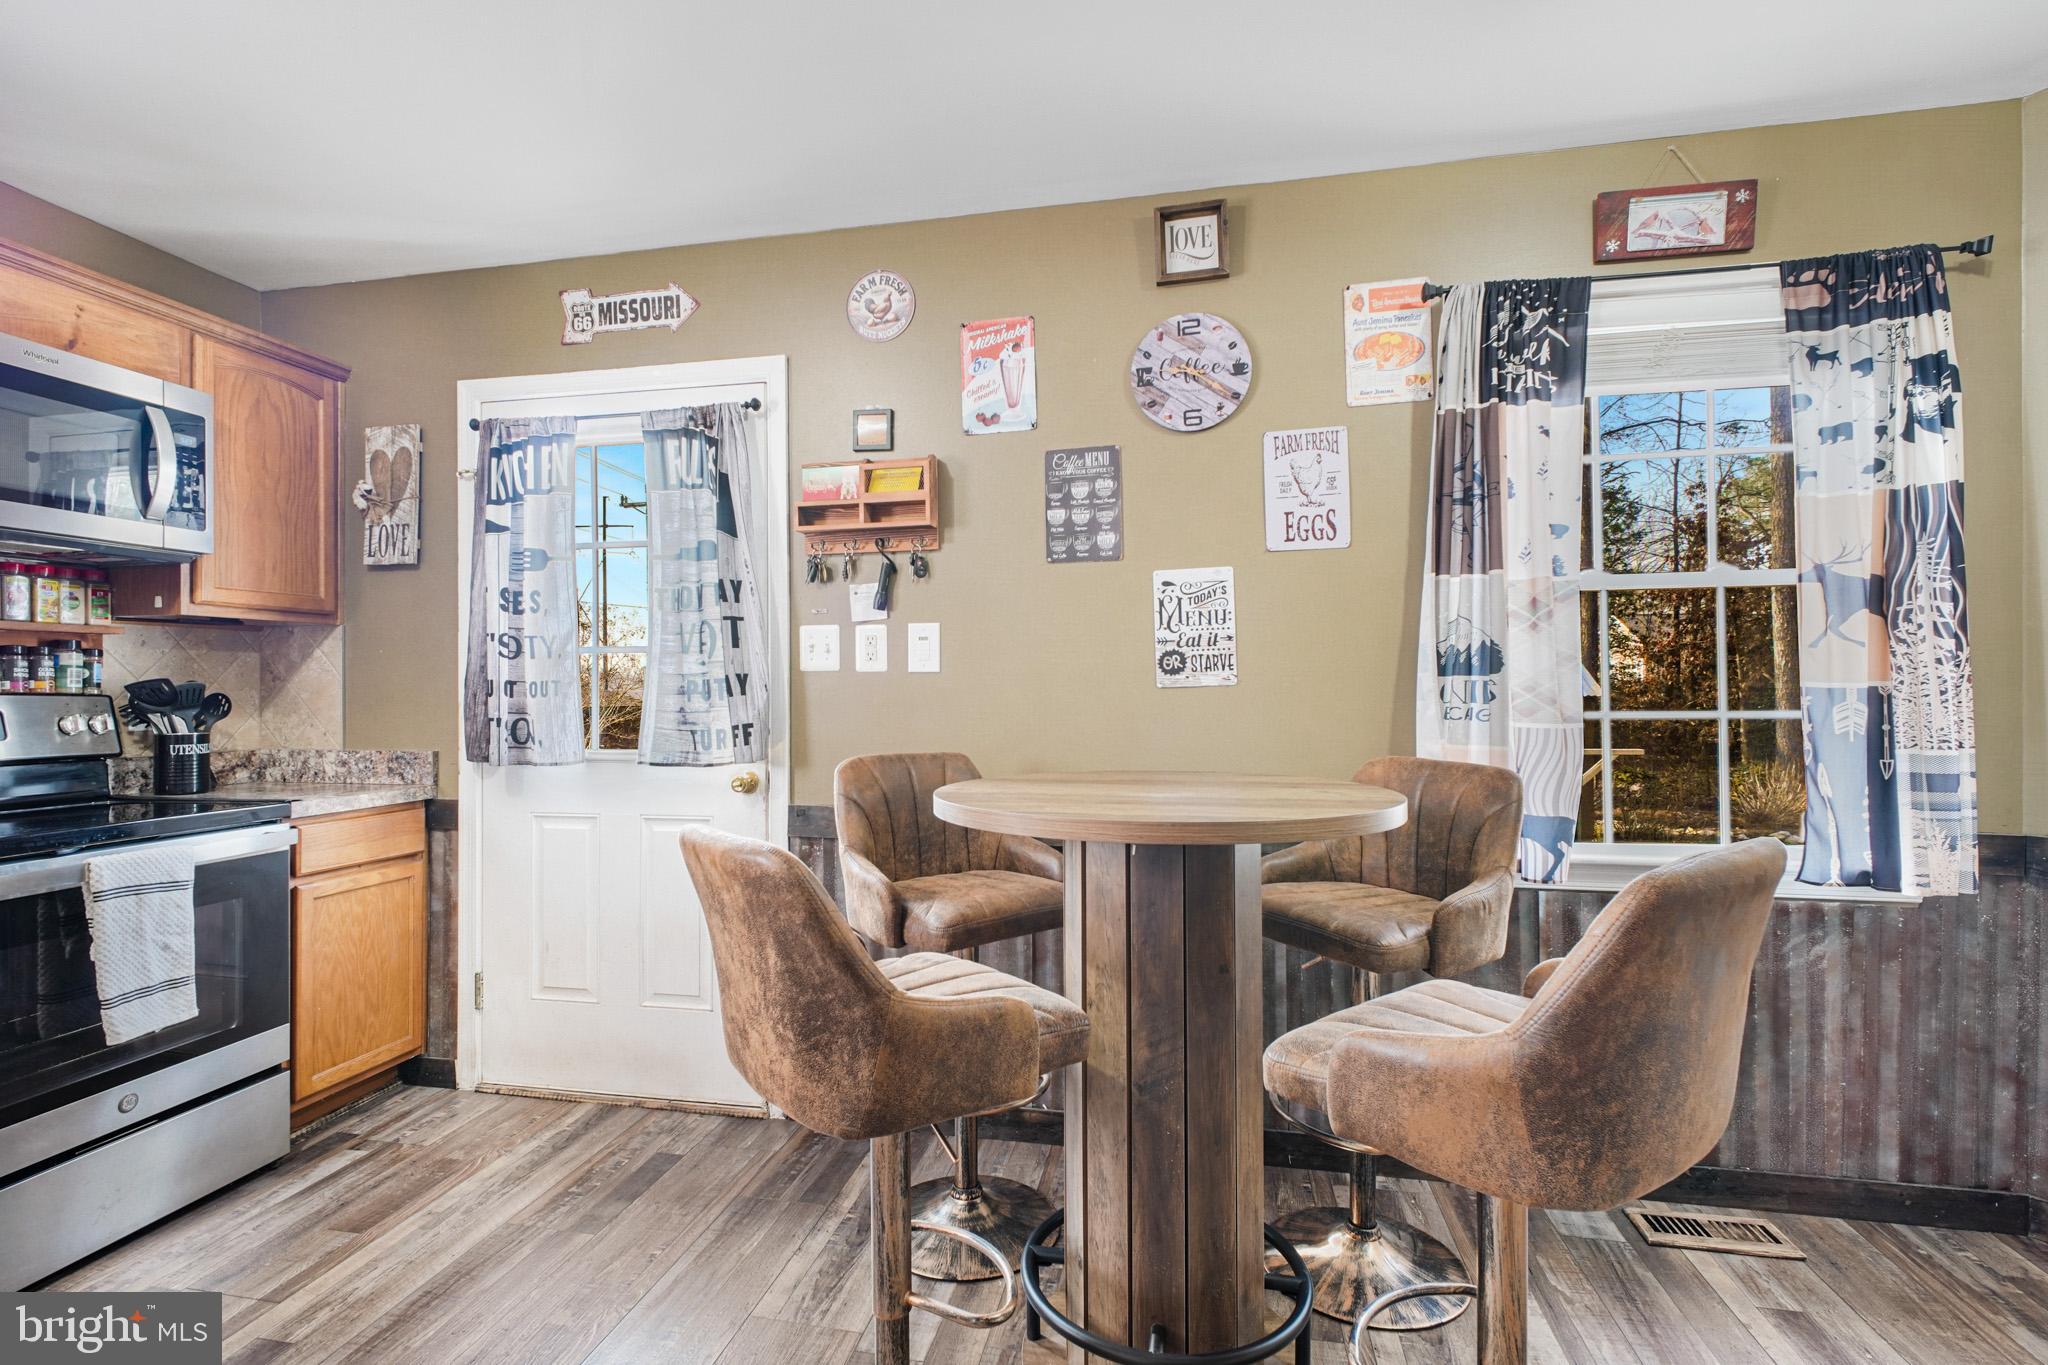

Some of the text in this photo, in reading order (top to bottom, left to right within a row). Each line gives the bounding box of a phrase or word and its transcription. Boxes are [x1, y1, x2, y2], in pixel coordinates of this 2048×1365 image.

[1168, 224, 1214, 258] LOVE
[852, 275, 908, 303] FARM FRESH
[598, 294, 681, 327] MISSOURI
[573, 316, 594, 331] 66
[1177, 318, 1201, 337] 12
[1159, 357, 1226, 384] Coffee
[1183, 408, 1203, 427] 6
[1273, 430, 1340, 461] FARM FRESH
[1052, 451, 1110, 474] Coffee MENU
[1283, 508, 1338, 543] EGGS
[367, 522, 410, 558] LOVE
[1187, 585, 1228, 607] TODAY'S
[1176, 631, 1220, 648] Eat it
[1162, 653, 1235, 673] OR STARVE
